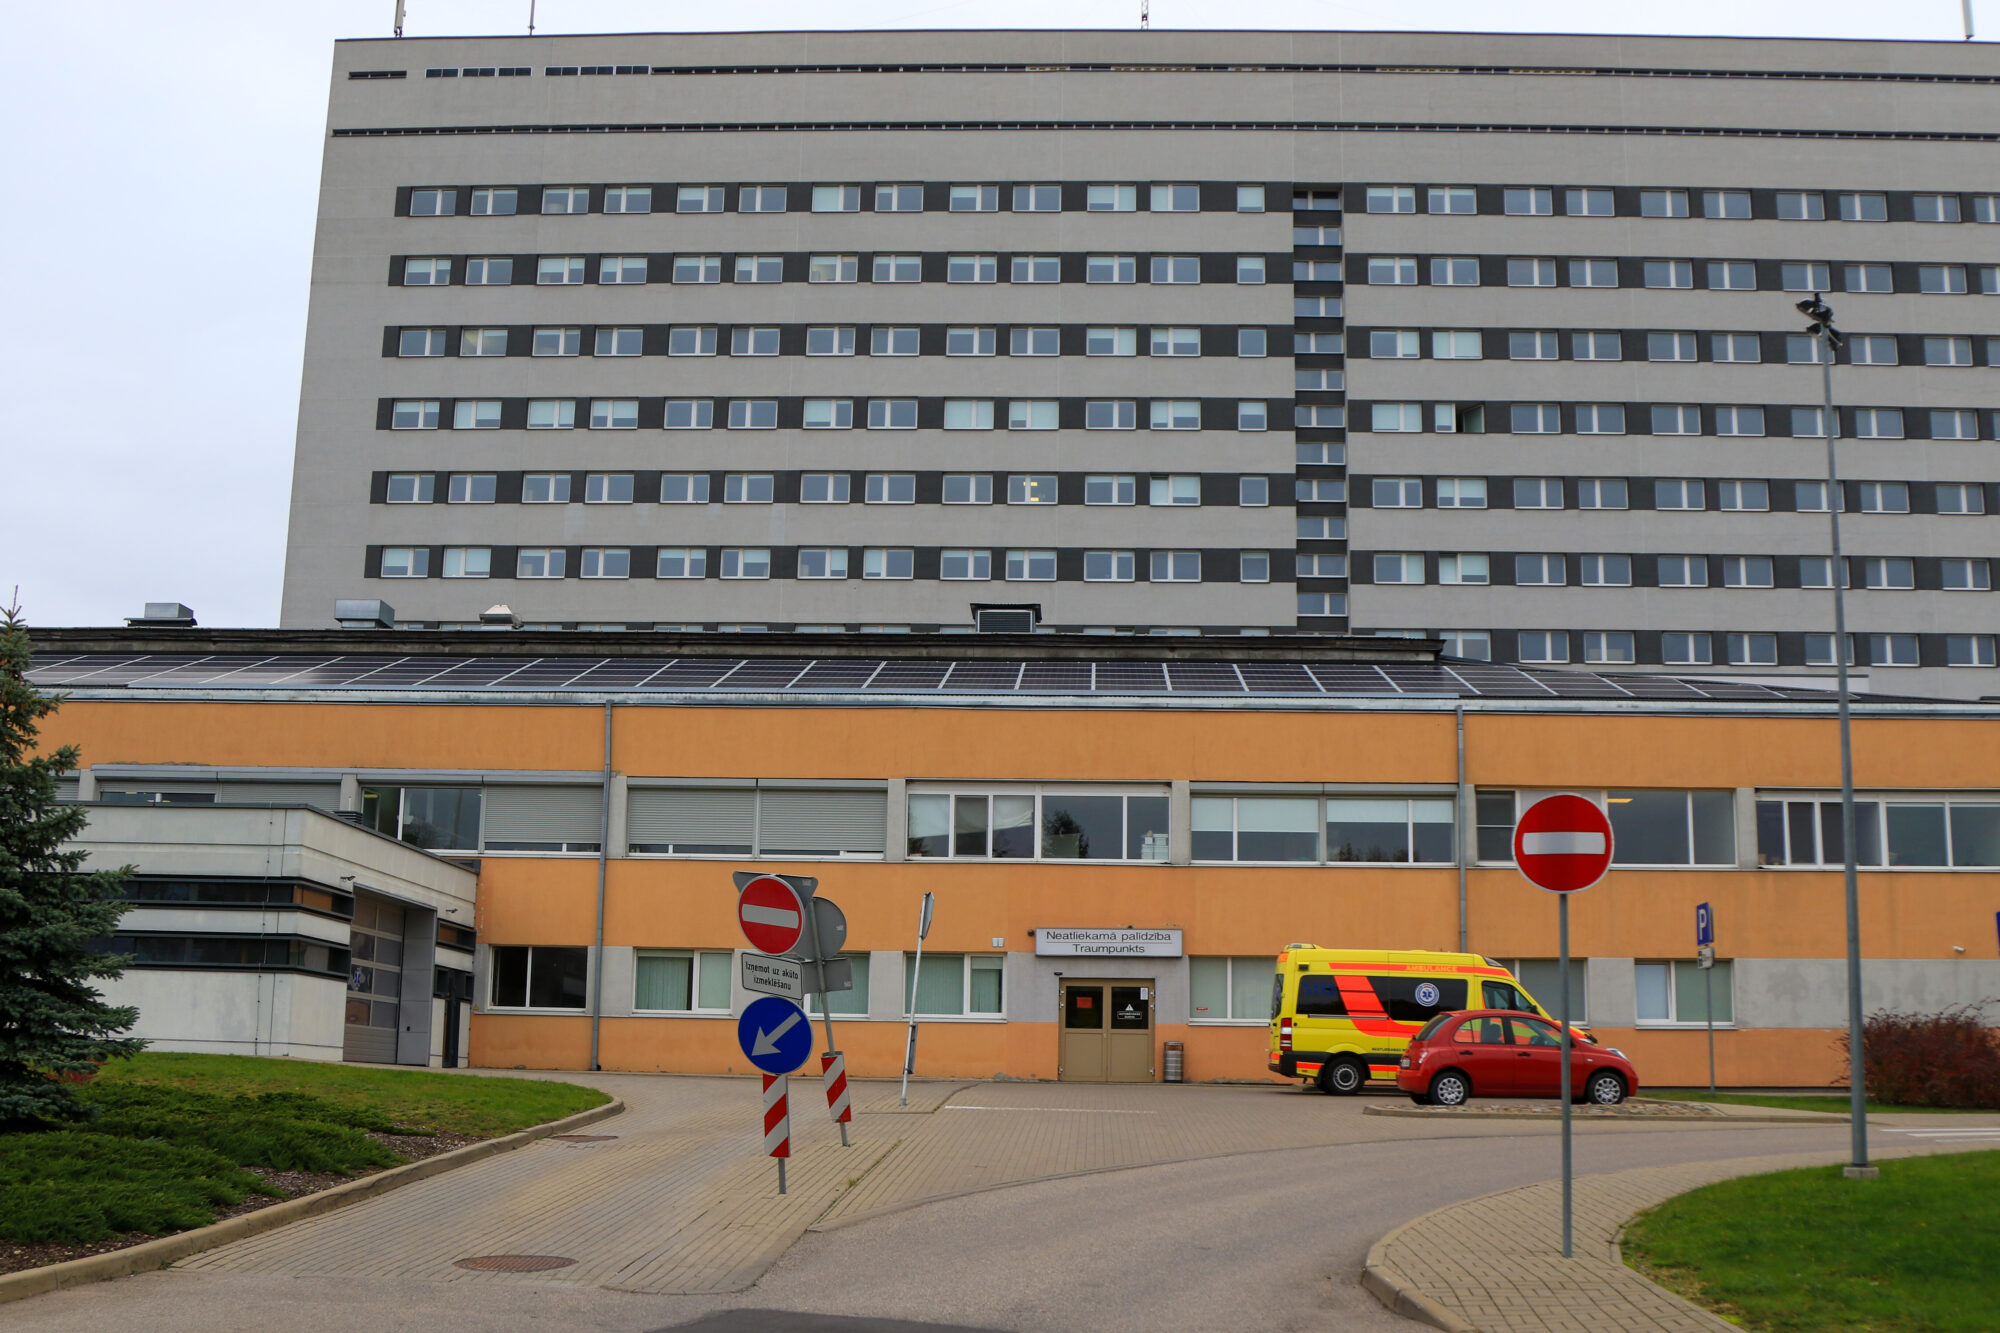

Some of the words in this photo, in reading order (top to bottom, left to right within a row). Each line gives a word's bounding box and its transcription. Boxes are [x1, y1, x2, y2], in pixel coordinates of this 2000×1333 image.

[1699, 908, 1707, 941] P
[1046, 931, 1117, 940] Neatliekamā
[1121, 931, 1171, 943] palīdzība
[1072, 943, 1145, 954] Traumpunkts
[745, 961, 770, 973] Izņemot
[773, 967, 779, 975] uz
[782, 968, 798, 979] akūto
[1406, 964, 1457, 973] AMBULANCE
[753, 975, 791, 990] izmeklēšanu
